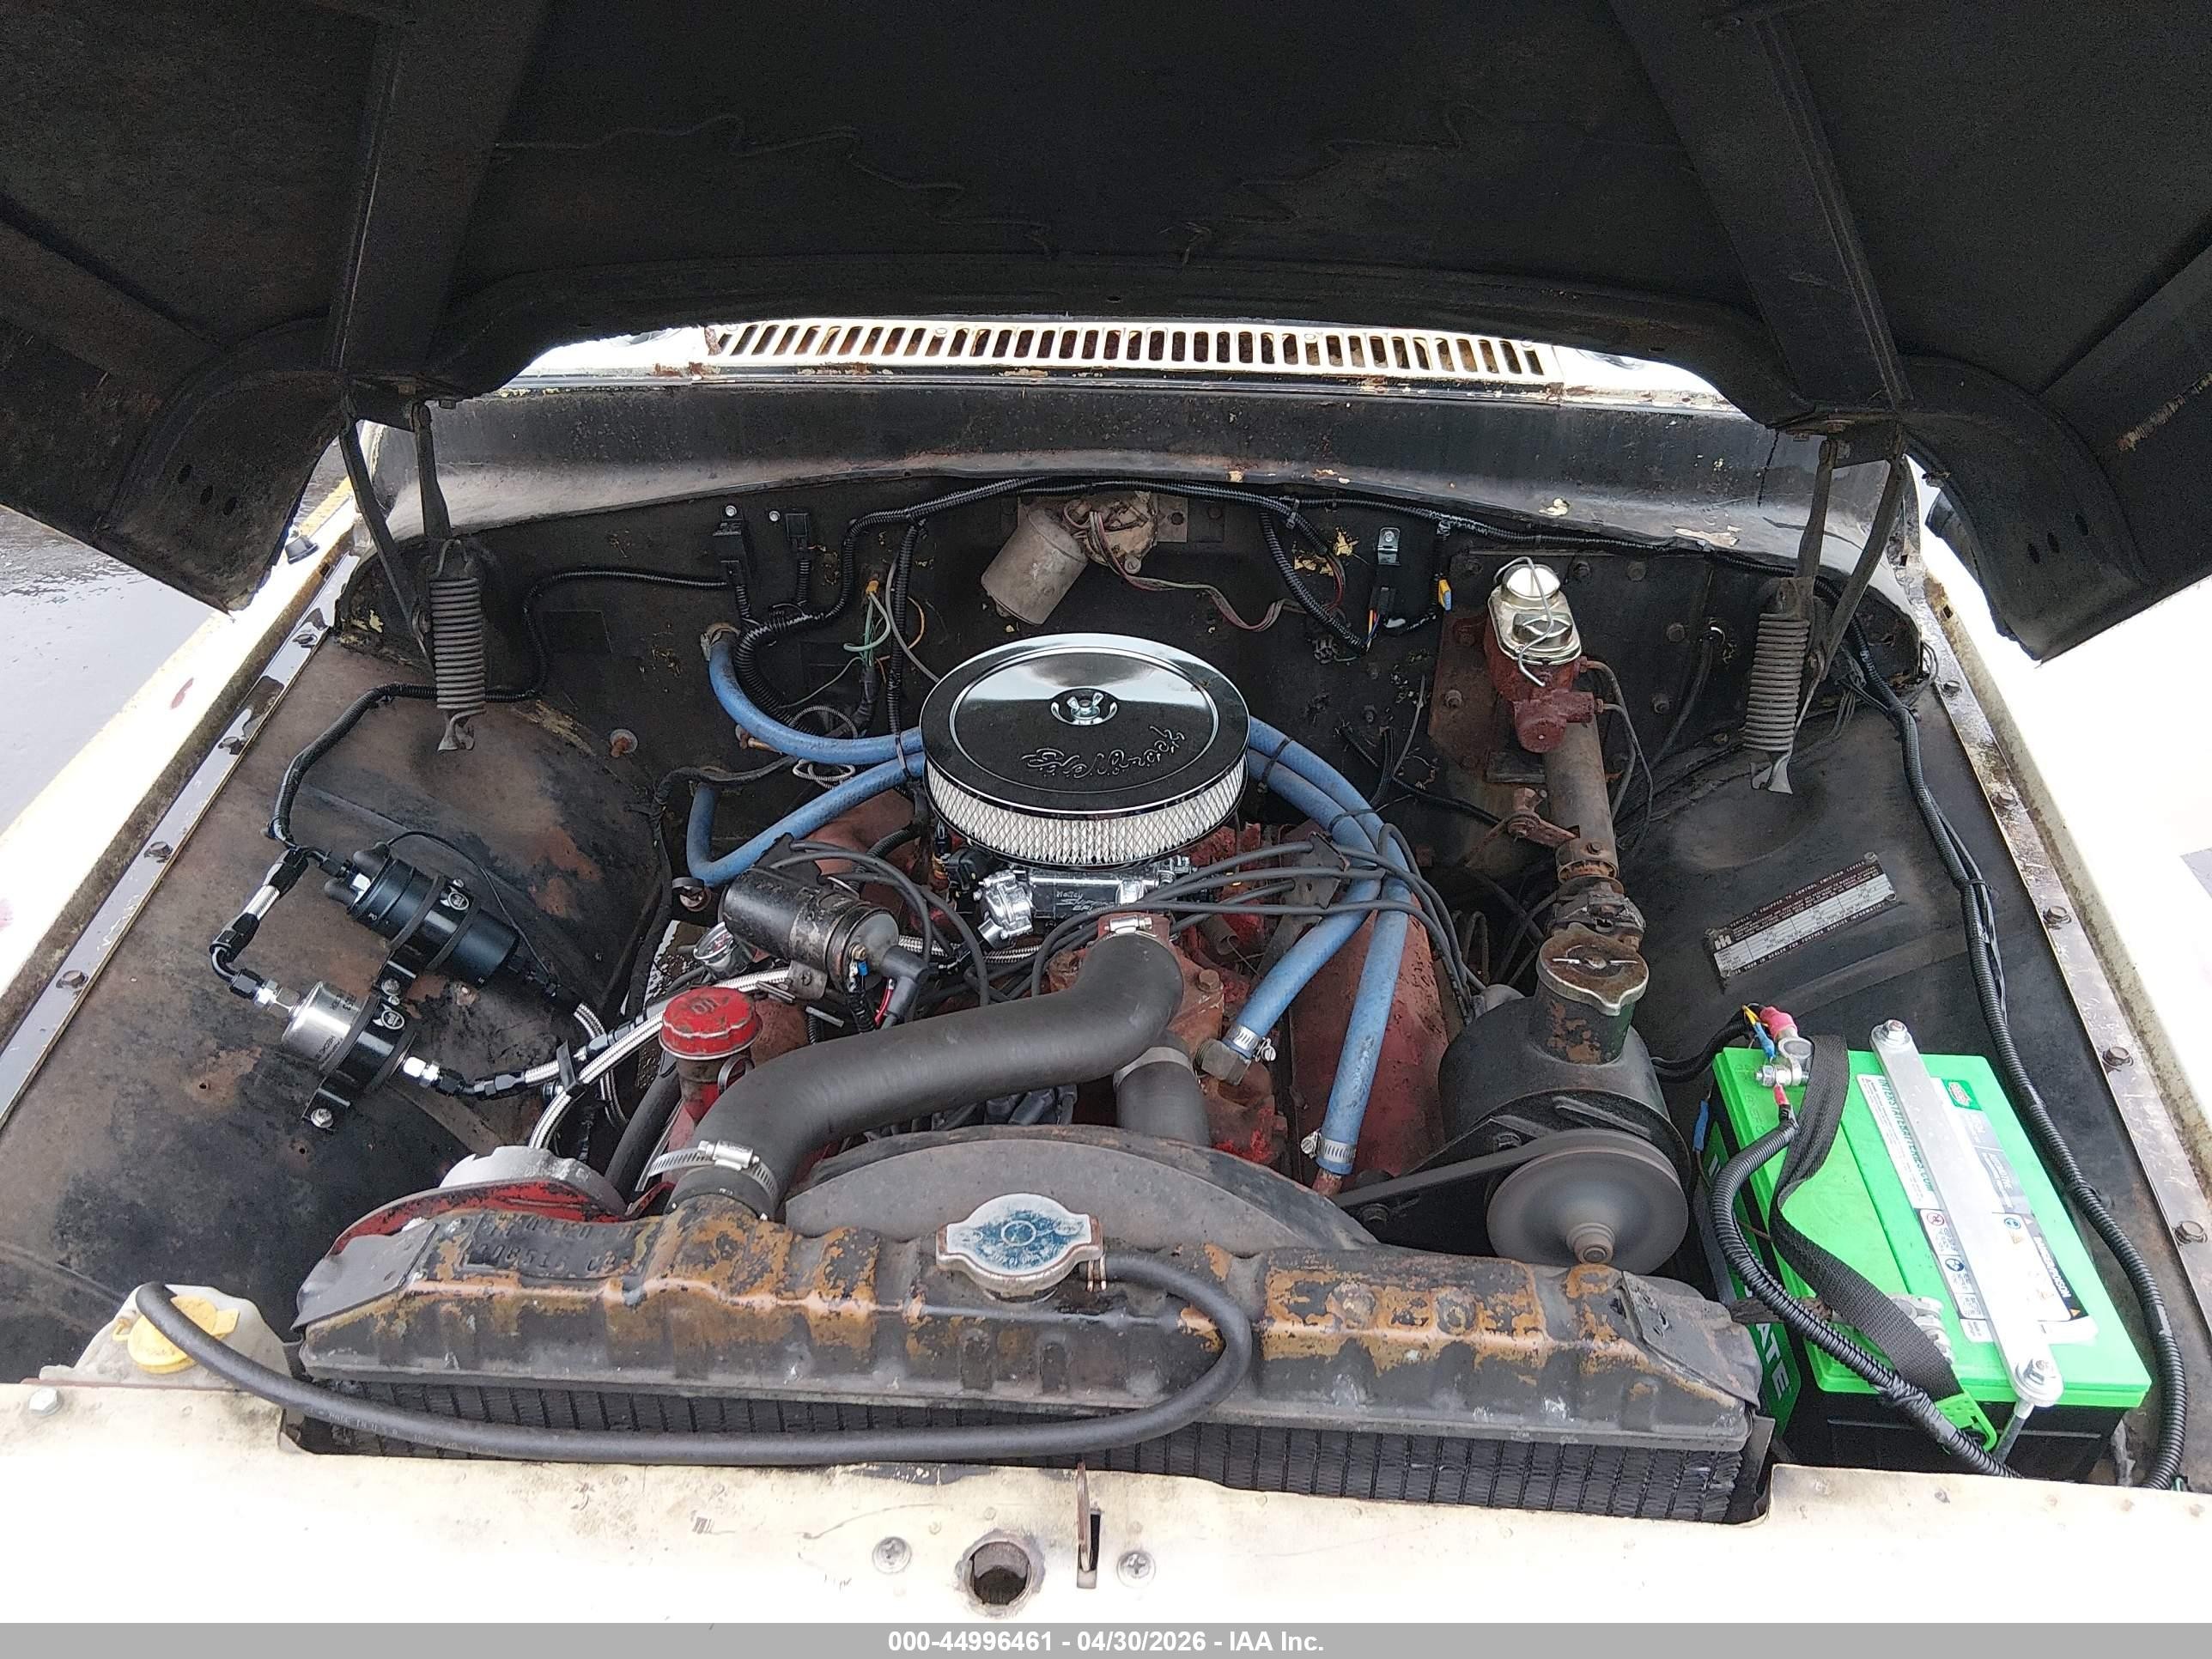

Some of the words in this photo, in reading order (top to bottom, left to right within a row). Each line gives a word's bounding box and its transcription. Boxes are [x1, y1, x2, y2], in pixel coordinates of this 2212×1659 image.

[1020, 725, 1186, 779] Edelbrock
[1056, 890, 1083, 902] Holley
[1794, 882, 1817, 896] CONTROL
